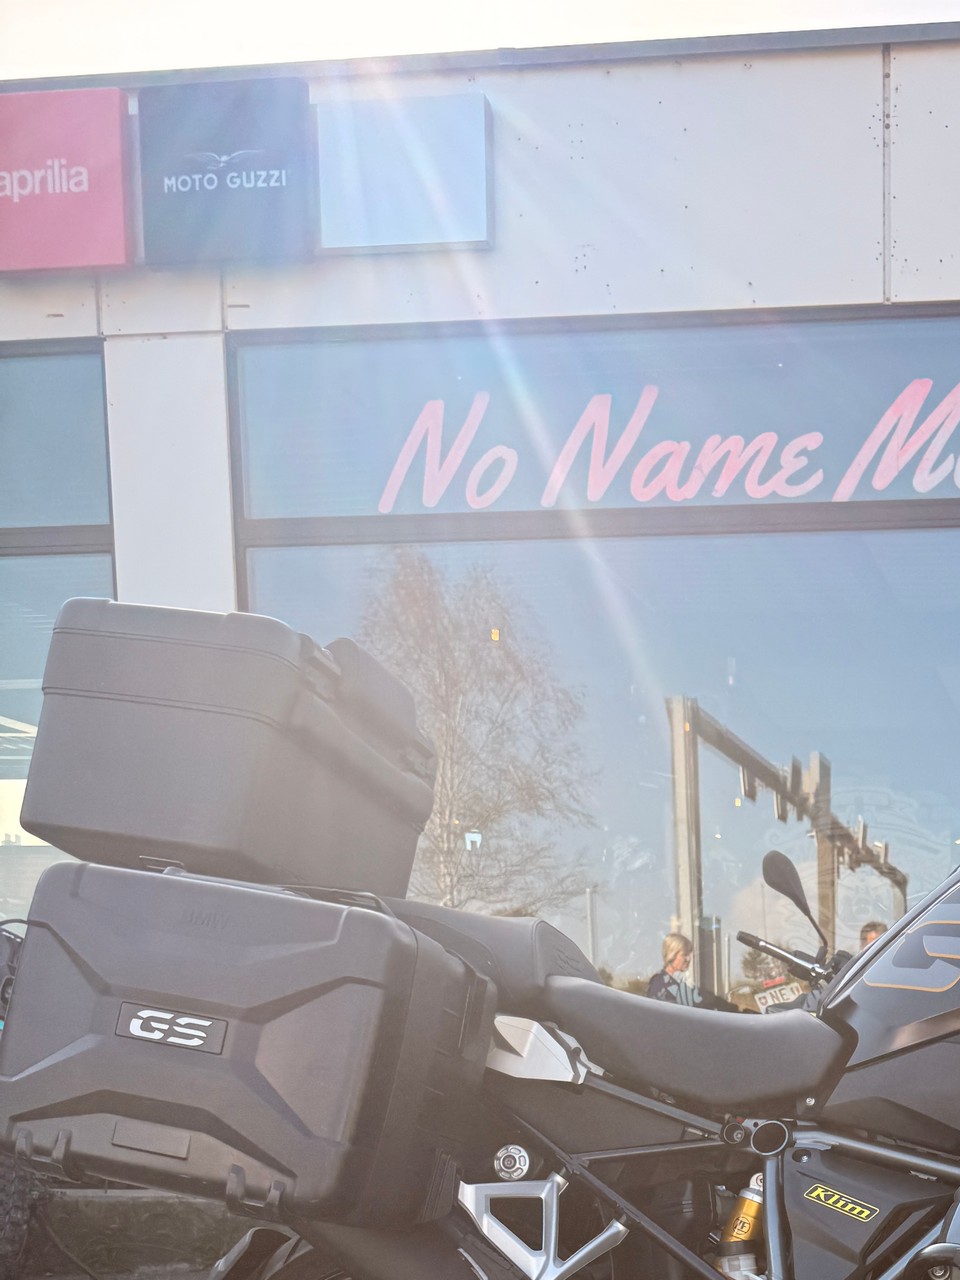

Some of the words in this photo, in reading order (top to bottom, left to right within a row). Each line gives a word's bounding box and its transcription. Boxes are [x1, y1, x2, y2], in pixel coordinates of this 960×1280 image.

[0, 159, 89, 202] aprilia
[163, 173, 218, 193] MOTO
[226, 169, 287, 189] GUZZI
[378, 392, 518, 513] No
[541, 384, 824, 508] Name
[129, 1009, 213, 1047] GS
